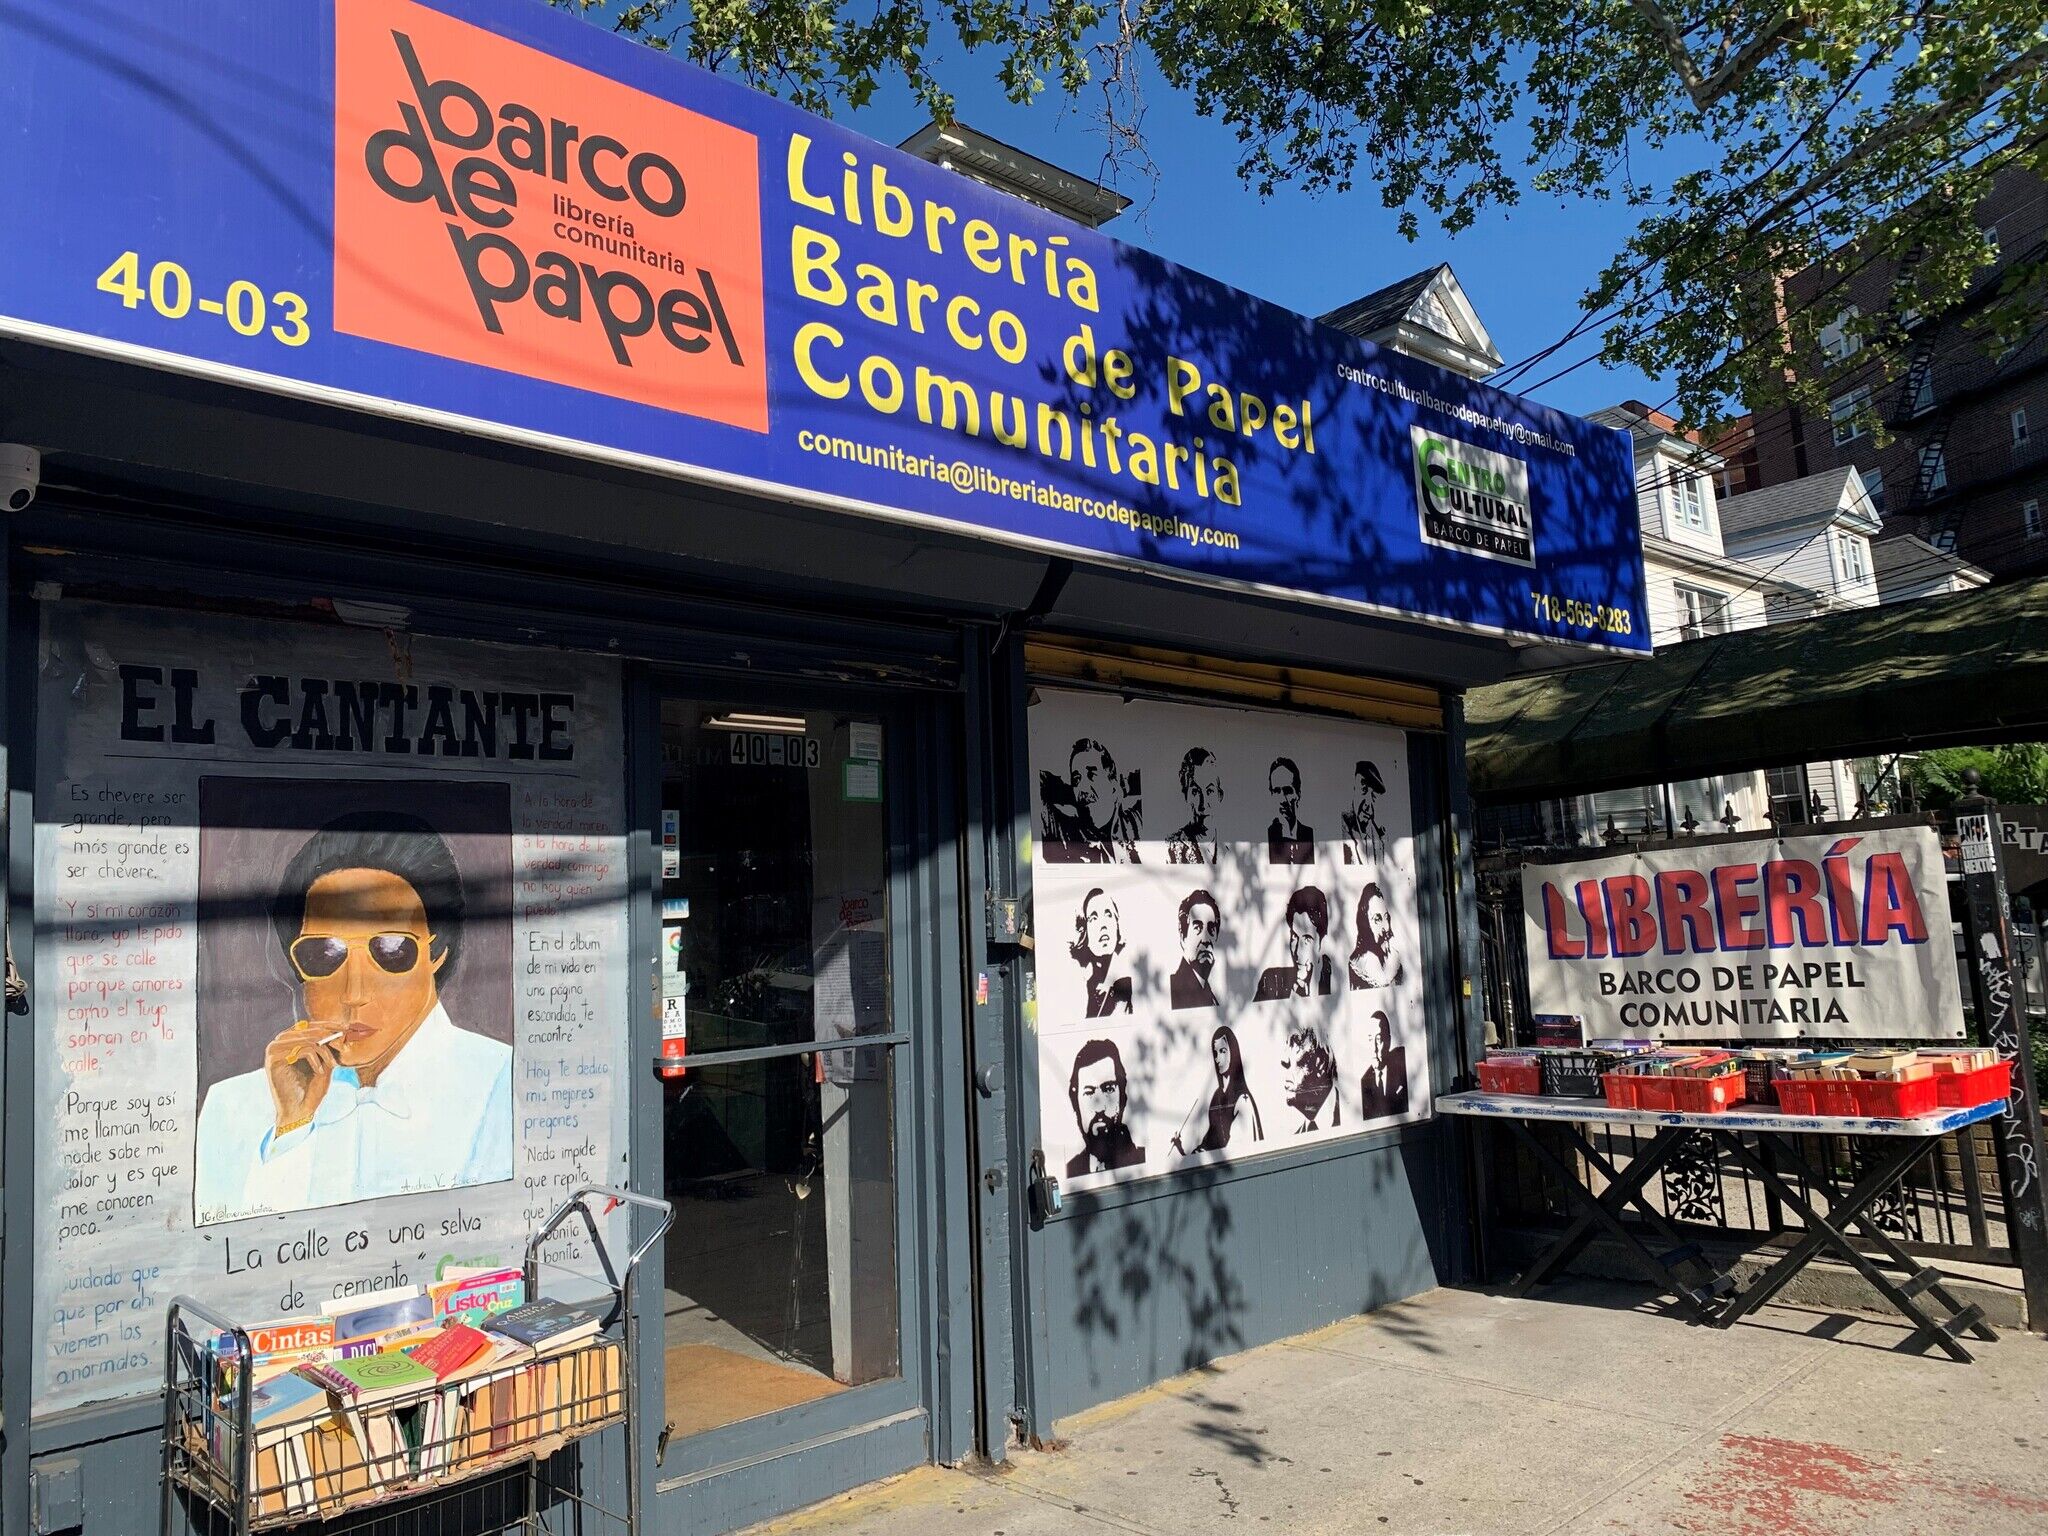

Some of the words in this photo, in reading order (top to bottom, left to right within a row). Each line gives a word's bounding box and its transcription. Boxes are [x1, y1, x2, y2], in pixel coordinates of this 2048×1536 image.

[391, 29, 687, 217] barco
[364, 101, 518, 228] de
[552, 194, 635, 239] librería
[787, 132, 1099, 312] Librería
[553, 222, 686, 276] comunitaria
[97, 251, 311, 346] 40-03
[446, 223, 745, 367] papel
[791, 224, 1028, 364] Barco
[1062, 323, 1136, 400] de
[1166, 355, 1316, 455] Papel
[793, 321, 1242, 507] Comunitaria
[1337, 362, 1576, 457] centroculturalbarcodepapelny@gmail.com
[1418, 439, 1506, 498] CENTRO
[797, 428, 1240, 550] comunitaria@libreriabarcodepapelny.com
[1422, 464, 1528, 529] CULTURAL
[1433, 521, 1470, 542] BARCO
[1477, 531, 1489, 547] DE
[1494, 536, 1524, 555] PAPEL
[1531, 591, 1632, 635] 718-565-8283
[119, 664, 215, 745] EL
[239, 675, 574, 761] CANTANTE
[731, 734, 820, 768] 40-03
[163, 792, 187, 804] ser
[73, 808, 132, 834] grande,
[141, 815, 171, 834] pero
[118, 834, 167, 863] grande
[175, 843, 190, 854] es
[536, 833, 545, 849] la
[552, 835, 575, 852] hora
[579, 835, 591, 853] de
[597, 837, 607, 853] la
[66, 865, 89, 878] ser
[567, 861, 609, 881] conmigo
[523, 881, 537, 893] no
[541, 877, 561, 901] hay
[566, 884, 592, 901] quien
[1542, 837, 1929, 961] LIBRERÍA
[105, 904, 123, 918] mi
[112, 929, 129, 947] yo
[137, 924, 149, 939] le
[154, 921, 182, 945] pido
[554, 930, 564, 950] el
[66, 954, 94, 975] que
[102, 953, 118, 966] se
[126, 948, 156, 966] calle
[526, 954, 541, 975] de
[545, 962, 557, 974] mi
[561, 956, 580, 974] vida
[584, 963, 597, 974] en
[68, 980, 125, 1000] porque
[132, 979, 183, 993] amores
[526, 986, 545, 997] una
[1600, 966, 1701, 997] BARCO
[1713, 965, 1755, 991] DE
[1764, 961, 1865, 990] PAPEL
[68, 1004, 109, 1020] como
[117, 999, 128, 1016] el
[136, 999, 168, 1027] tuyo
[527, 1003, 577, 1022] escondida
[581, 998, 594, 1021] te
[1619, 996, 1850, 1028] COMUNITARIA
[68, 1026, 122, 1049] sobran
[131, 1030, 148, 1043] en
[162, 1020, 174, 1040] la
[558, 1059, 570, 1077] te
[577, 1056, 609, 1076] dedico
[66, 1091, 118, 1120] Porque
[127, 1098, 151, 1117] soy
[157, 1091, 177, 1107] así
[526, 1089, 547, 1102] mis
[551, 1087, 595, 1109] mejores
[65, 1127, 89, 1143] me
[95, 1120, 139, 1139] llaman
[149, 1113, 178, 1133] loco,
[64, 1143, 102, 1165] nadie
[108, 1142, 141, 1161] sabe
[147, 1142, 164, 1157] mi
[561, 1132, 597, 1165] impide
[107, 1173, 117, 1194] y
[127, 1168, 145, 1182] es
[151, 1165, 178, 1187] que
[524, 1175, 547, 1201] que
[61, 1202, 88, 1219] me
[96, 1194, 154, 1212] conocen
[523, 1206, 545, 1232] que
[277, 1228, 329, 1264] calle
[345, 1230, 369, 1252] es
[388, 1222, 425, 1244] una
[440, 1208, 482, 1237] selva
[64, 1264, 122, 1290] uidado
[132, 1266, 160, 1292] que
[280, 1280, 305, 1311] de
[54, 1306, 86, 1335] que
[95, 1300, 125, 1330] por
[53, 1332, 109, 1355] vienen
[120, 1320, 142, 1340] los
[253, 1328, 332, 1354] Cintas
